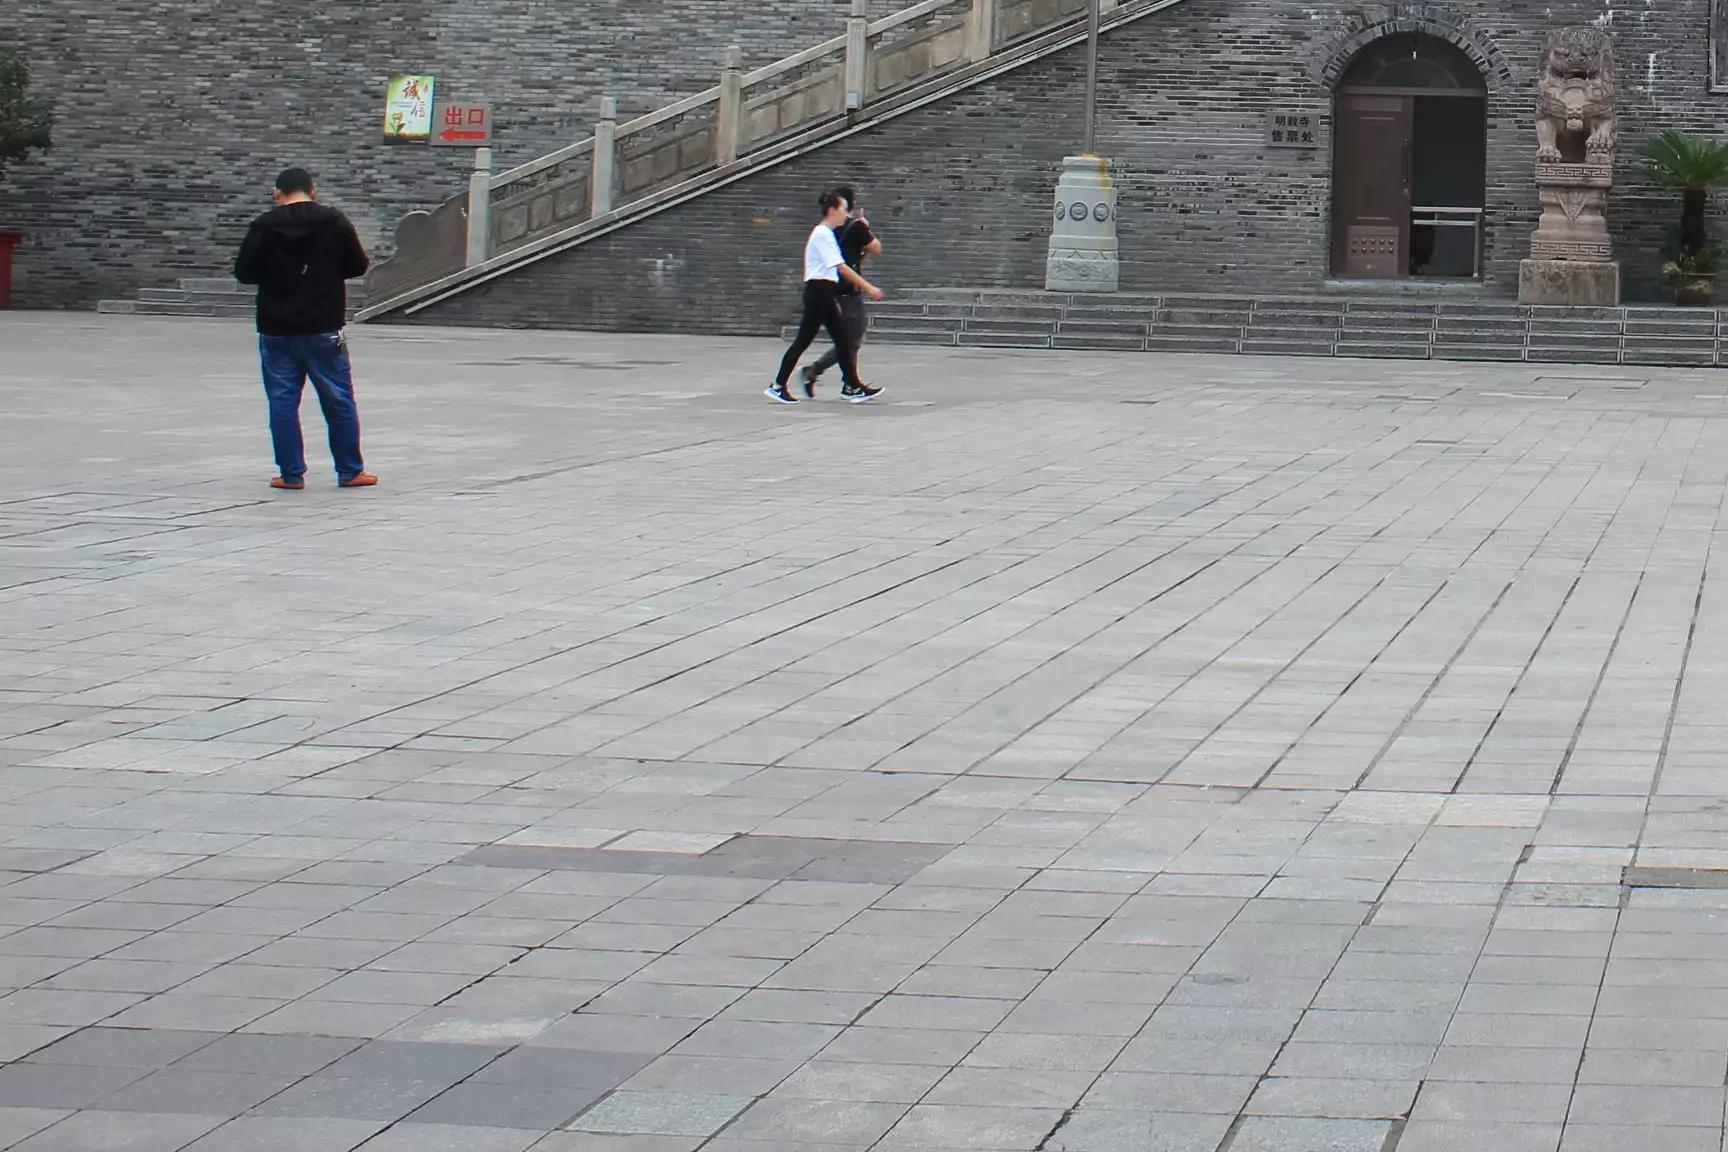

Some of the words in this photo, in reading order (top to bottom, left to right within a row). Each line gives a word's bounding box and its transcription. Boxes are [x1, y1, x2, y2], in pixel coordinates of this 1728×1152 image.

[445, 105, 484, 125] 出口
[1275, 115, 1310, 127] 明教寺
[1272, 129, 1314, 143] 售票处
